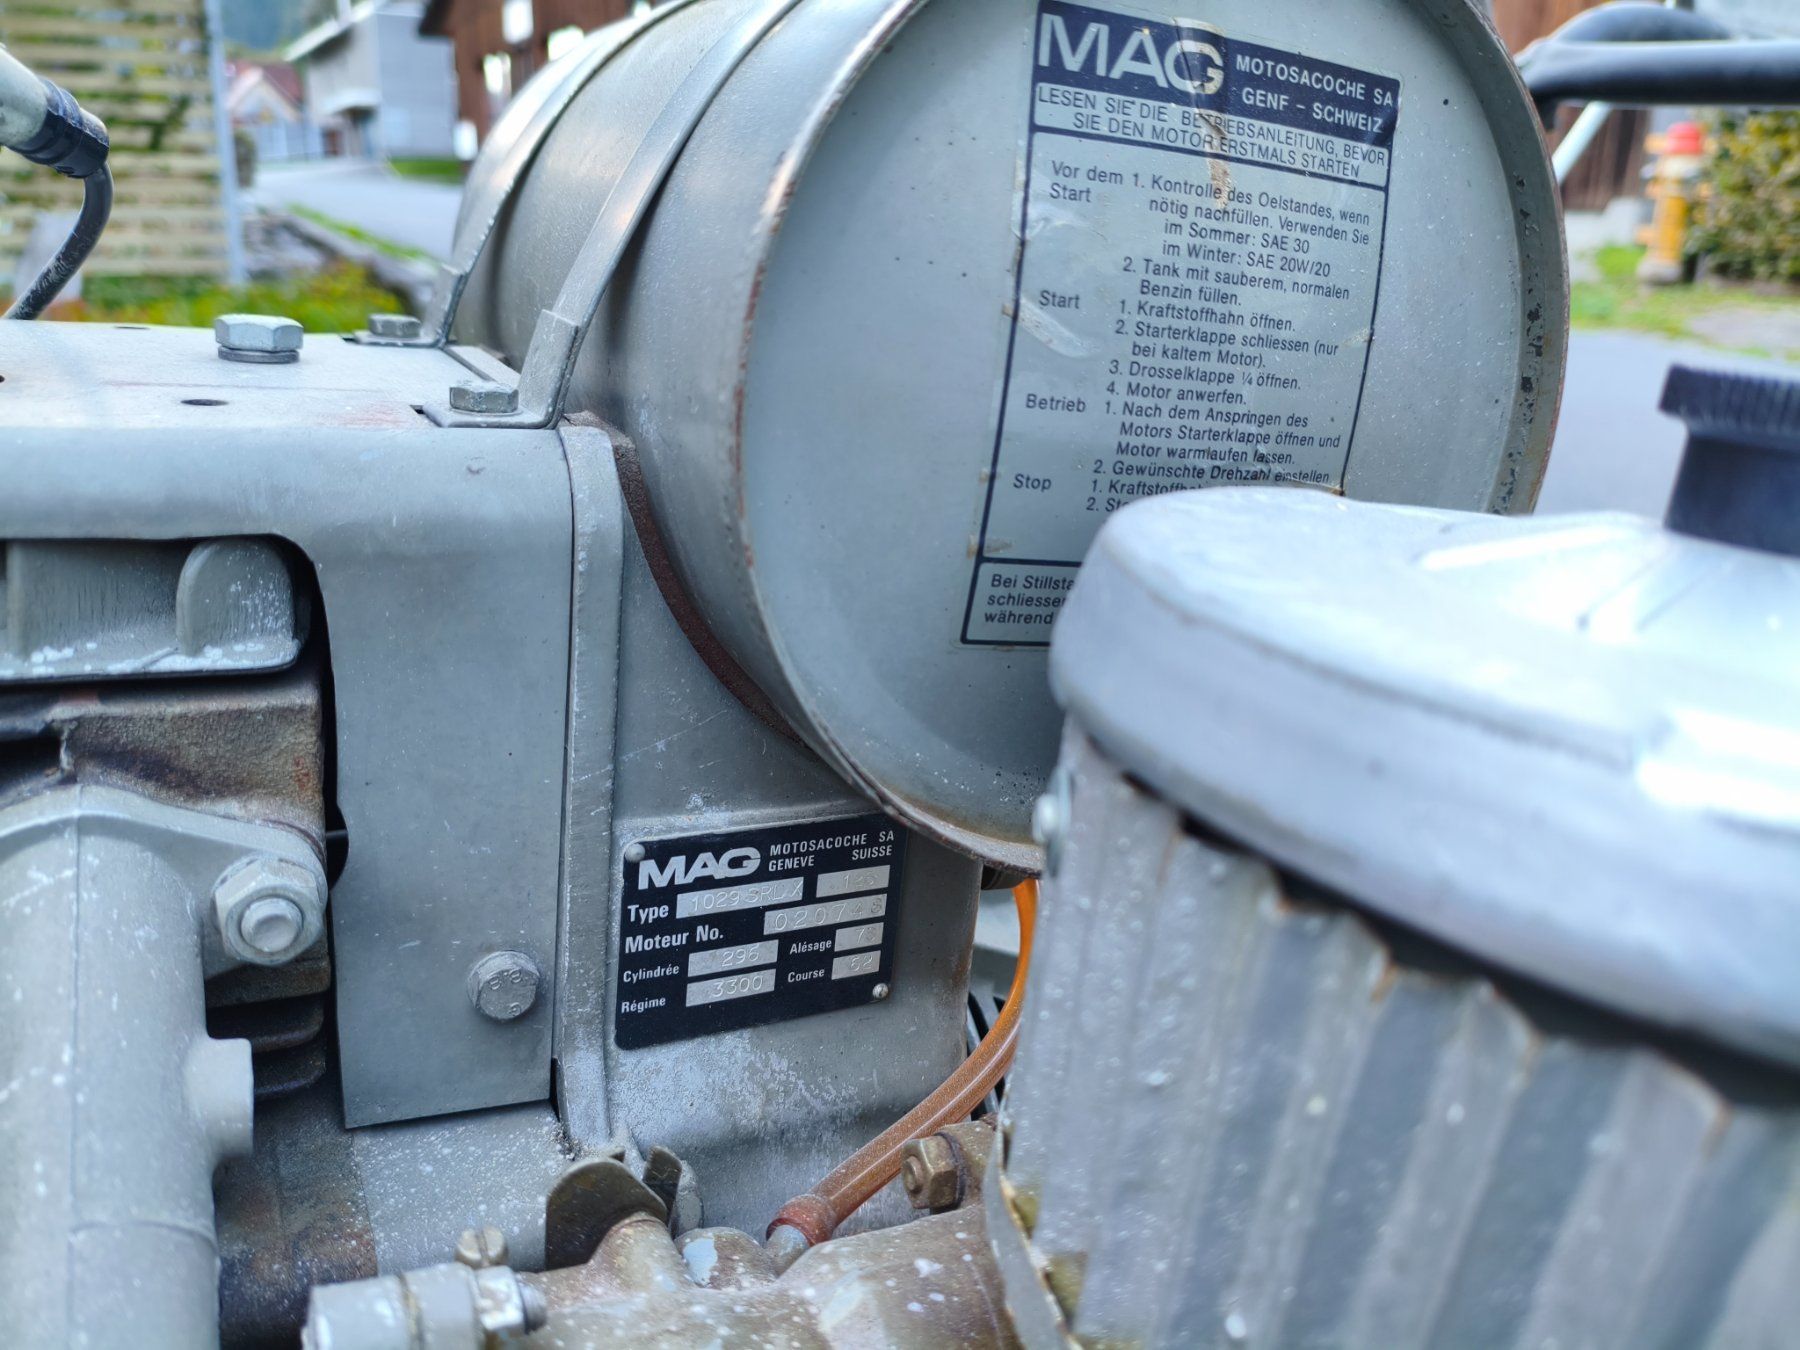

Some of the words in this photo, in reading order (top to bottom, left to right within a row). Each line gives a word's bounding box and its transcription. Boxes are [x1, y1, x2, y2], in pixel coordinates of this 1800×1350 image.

[1038, 12, 1225, 95] MAG
[1236, 54, 1365, 100] MOTOSACOCHE
[1373, 88, 1393, 107] SA
[1242, 87, 1289, 110] GENF
[1312, 102, 1383, 133] SCHWEIZ
[1037, 86, 1096, 110] LESEN
[1104, 97, 1132, 116] SIE
[1140, 103, 1168, 122] DIE
[1344, 143, 1385, 166] BEVOR
[1073, 112, 1100, 131] SIE
[1108, 118, 1144, 138] DEN
[1151, 124, 1214, 149] MOTOR
[1219, 138, 1296, 165] ERSTMALS
[1301, 153, 1360, 178] STARTEN
[1052, 160, 1080, 178] Vor
[1087, 166, 1123, 185] dem
[1050, 183, 1091, 202] Start
[1133, 173, 1145, 188] 1.
[1151, 174, 1222, 199] Kontrolle
[1227, 186, 1252, 204] des
[1259, 192, 1334, 220] Oelstandes,
[1339, 208, 1369, 226] wenn
[1150, 197, 1188, 219] nötig
[1194, 206, 1273, 229] nachfüllen.
[1278, 215, 1347, 241] Verwenden
[1352, 229, 1369, 245] Sie
[1164, 219, 1182, 235] im
[1188, 222, 1255, 246] Sommer:
[1261, 233, 1289, 251] SAE
[1293, 238, 1310, 254] 30
[1162, 240, 1180, 257] im
[1187, 243, 1241, 265] Winter:
[1246, 251, 1275, 269] SAE
[1280, 256, 1331, 277] 20W/20
[1122, 256, 1136, 273] 2.
[1143, 258, 1180, 278] Tank
[1186, 266, 1209, 281] mit
[1214, 270, 1287, 294] sauberem,
[1292, 281, 1350, 300] normalen
[1039, 290, 1080, 309] Start
[1140, 279, 1192, 300] Benzin
[1198, 286, 1242, 306] füllen.
[1119, 299, 1132, 315] 1.
[1137, 300, 1244, 326] Kraftstoffhahn
[1250, 312, 1296, 332] öffnen.
[1115, 319, 1128, 335] 2.
[1134, 321, 1236, 346] Starterklappe
[1241, 333, 1309, 353] schliessen
[1314, 340, 1339, 356] (nur
[1131, 341, 1156, 358] bei
[1161, 344, 1211, 362] kaltem
[1217, 349, 1266, 369] Motor).
[1108, 359, 1123, 375] 3.
[1129, 361, 1235, 386] Drosselklappe
[1256, 372, 1301, 390] öffnen.
[1025, 393, 1086, 413] Betrieb
[1106, 380, 1120, 396] 4.
[1126, 381, 1172, 400] Motor
[1176, 388, 1247, 405] anwerfen.
[1105, 400, 1117, 415] 1.
[1122, 401, 1162, 418] Nach
[1168, 404, 1200, 421] dem
[1205, 407, 1281, 428] Anspringen
[1286, 413, 1309, 428] des
[1119, 421, 1173, 439] Motors
[1177, 424, 1271, 446] Starterklappe
[1275, 431, 1315, 447] öffnen
[1318, 434, 1341, 449] und
[1116, 440, 1162, 458] Motor
[1166, 446, 1248, 462] warmlaufen
[1253, 448, 1295, 465] lassen.
[1013, 473, 1052, 491] Stop
[1093, 459, 1107, 475] 2.
[1112, 460, 1205, 480] Gewünschte
[1210, 464, 1272, 481] Drehzahl
[1091, 479, 1103, 493] 1.
[1085, 497, 1099, 512] 2.
[991, 573, 1018, 589] Bei
[984, 609, 1055, 625] während
[769, 833, 868, 857] MOTOSACOCHE
[878, 830, 895, 843] SA
[638, 847, 761, 890] MAG
[768, 855, 815, 872] GENEVE
[851, 845, 893, 861] SUISSE
[627, 904, 669, 925] Type
[624, 931, 689, 954] Moteur
[696, 924, 724, 943] No.
[623, 963, 680, 985] Cylindrée
[789, 939, 832, 955] Alésage
[621, 997, 667, 1014] Régime
[709, 975, 764, 999] 3300
[787, 968, 825, 983] Course
